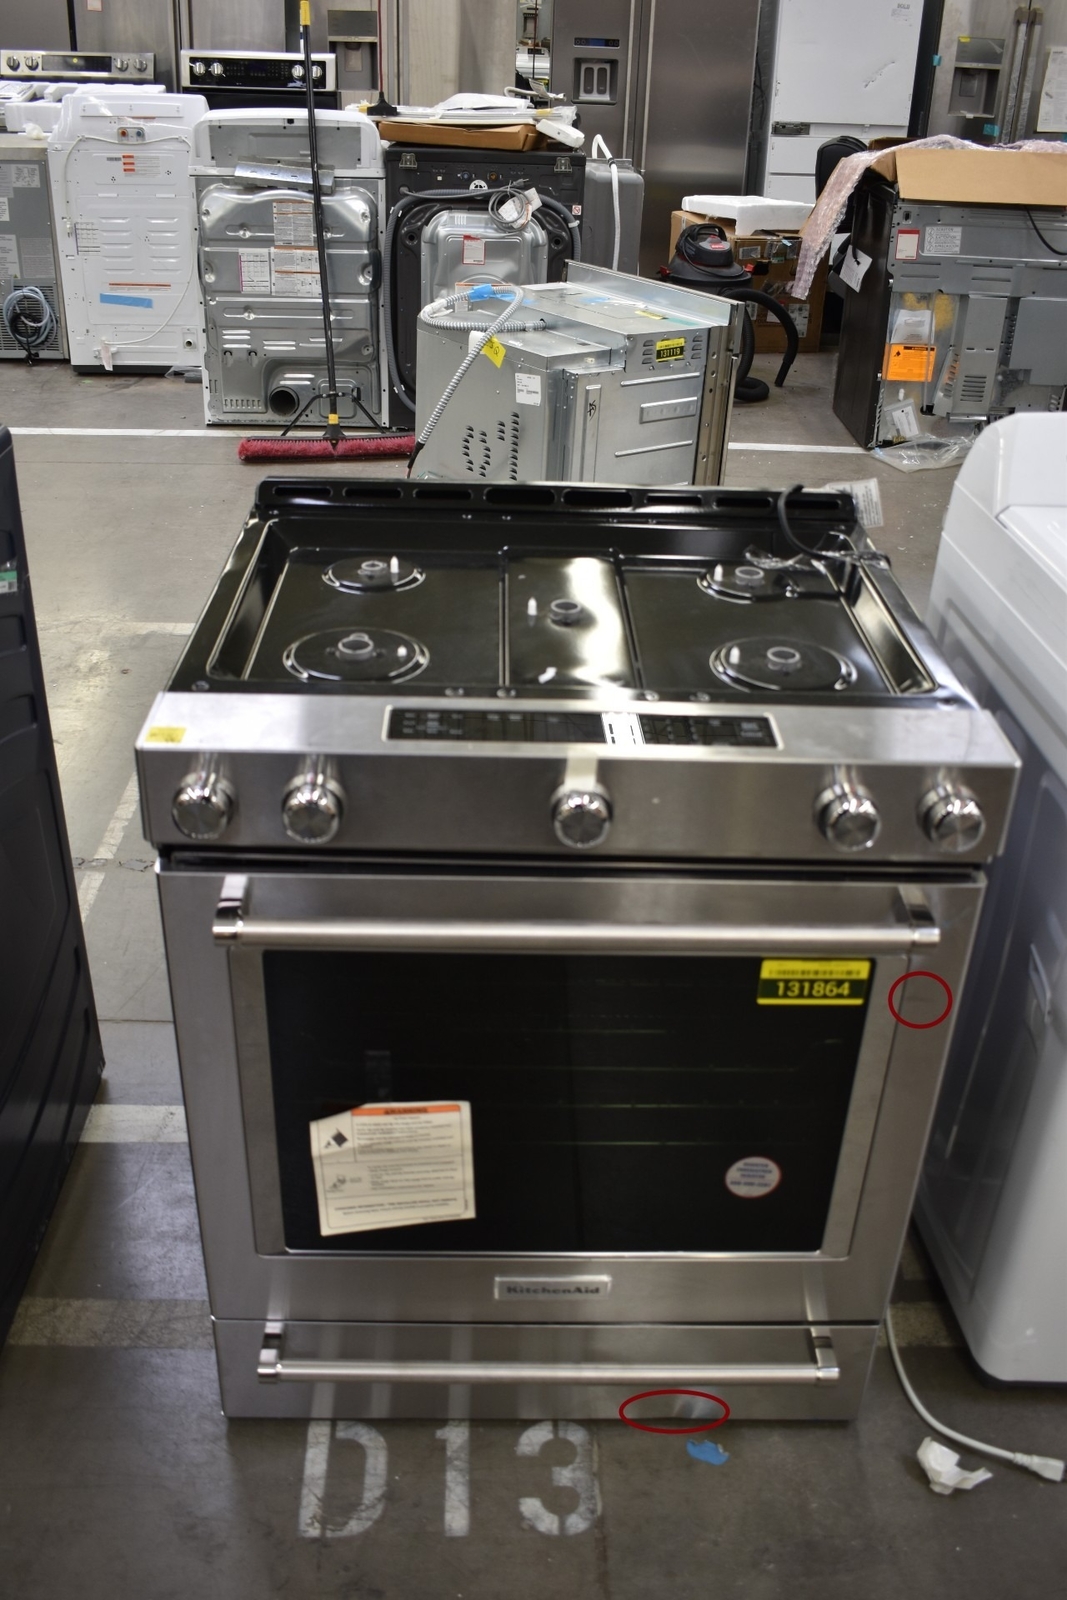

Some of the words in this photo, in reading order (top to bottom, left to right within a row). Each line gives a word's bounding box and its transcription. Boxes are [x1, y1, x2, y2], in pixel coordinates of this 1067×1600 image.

[660, 347, 680, 358] 131119
[776, 981, 850, 997] 131864
[506, 1286, 600, 1294] KitchenAid
[299, 1420, 600, 1537] D13
